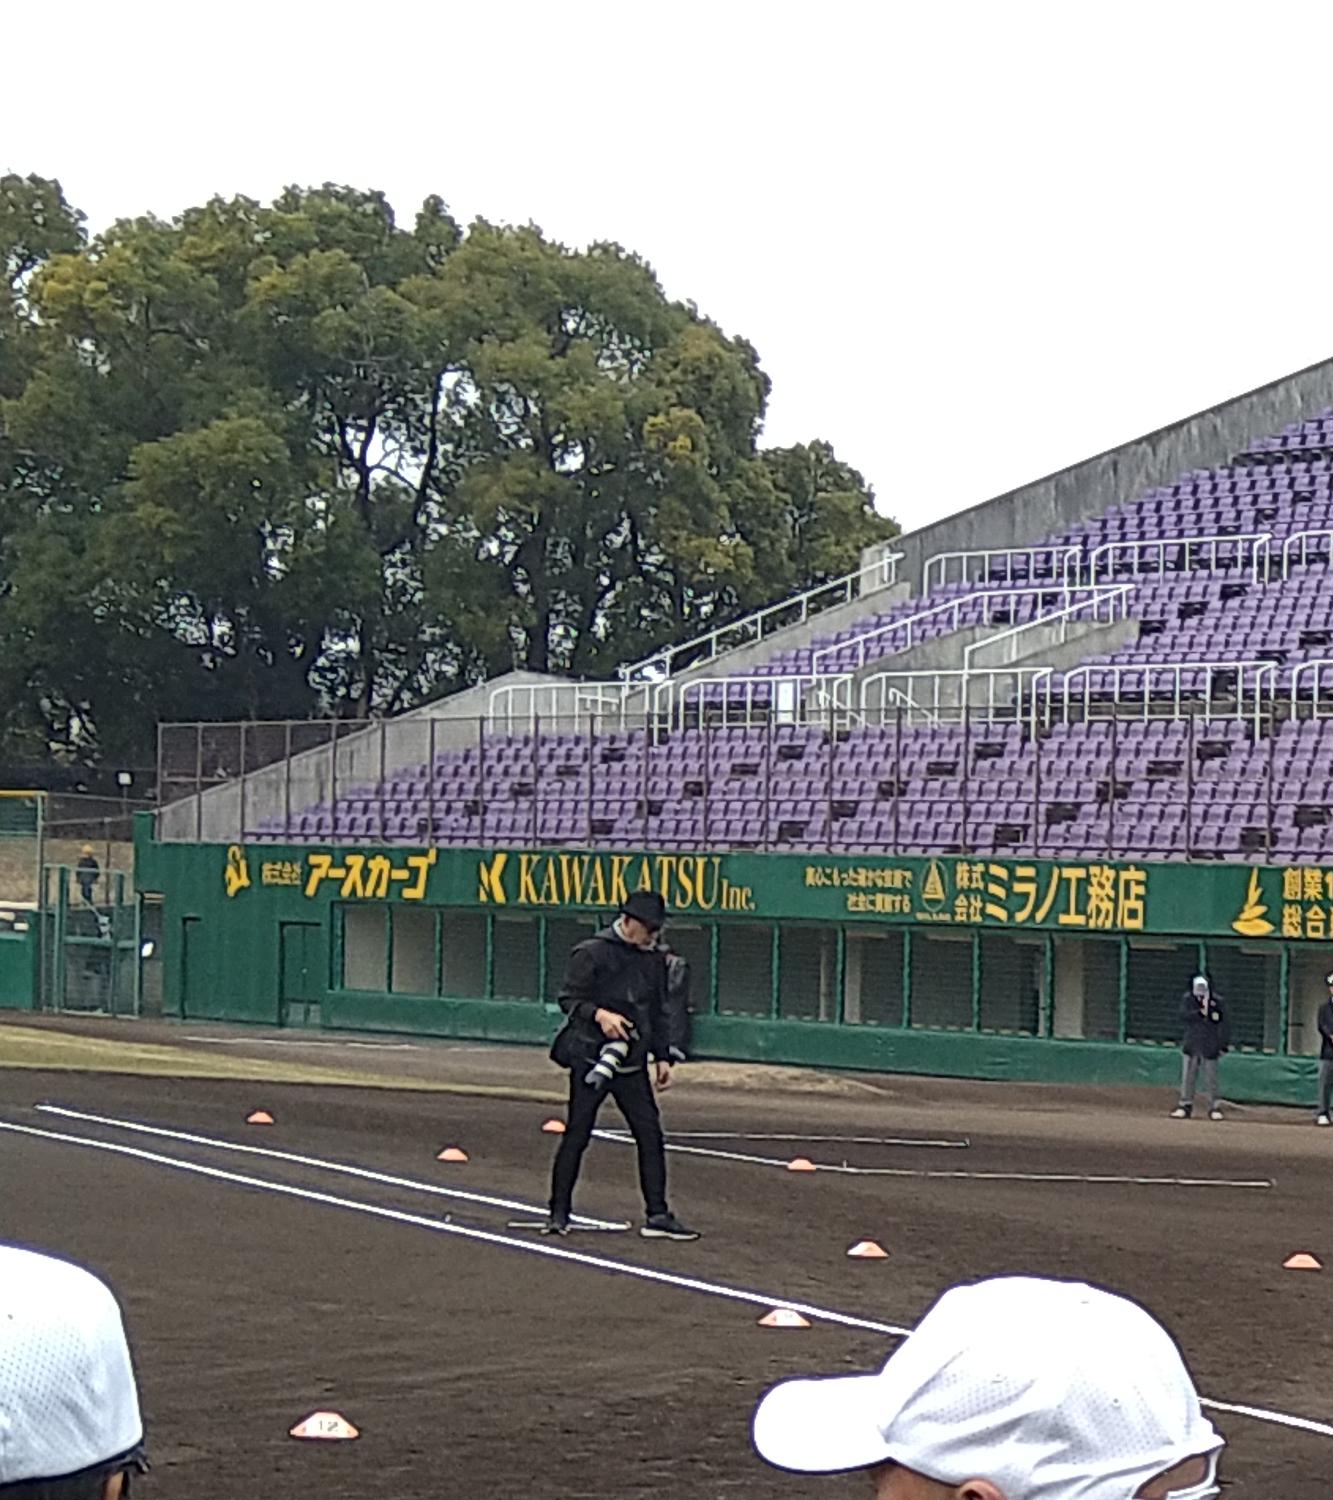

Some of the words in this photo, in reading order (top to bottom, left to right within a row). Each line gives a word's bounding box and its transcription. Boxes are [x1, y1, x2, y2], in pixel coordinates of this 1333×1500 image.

[305, 848, 436, 899] アースカーゴ
[518, 853, 720, 910] KAWAKATSU
[721, 879, 756, 910] Inc.
[985, 863, 1147, 929] ミラノ工務店
